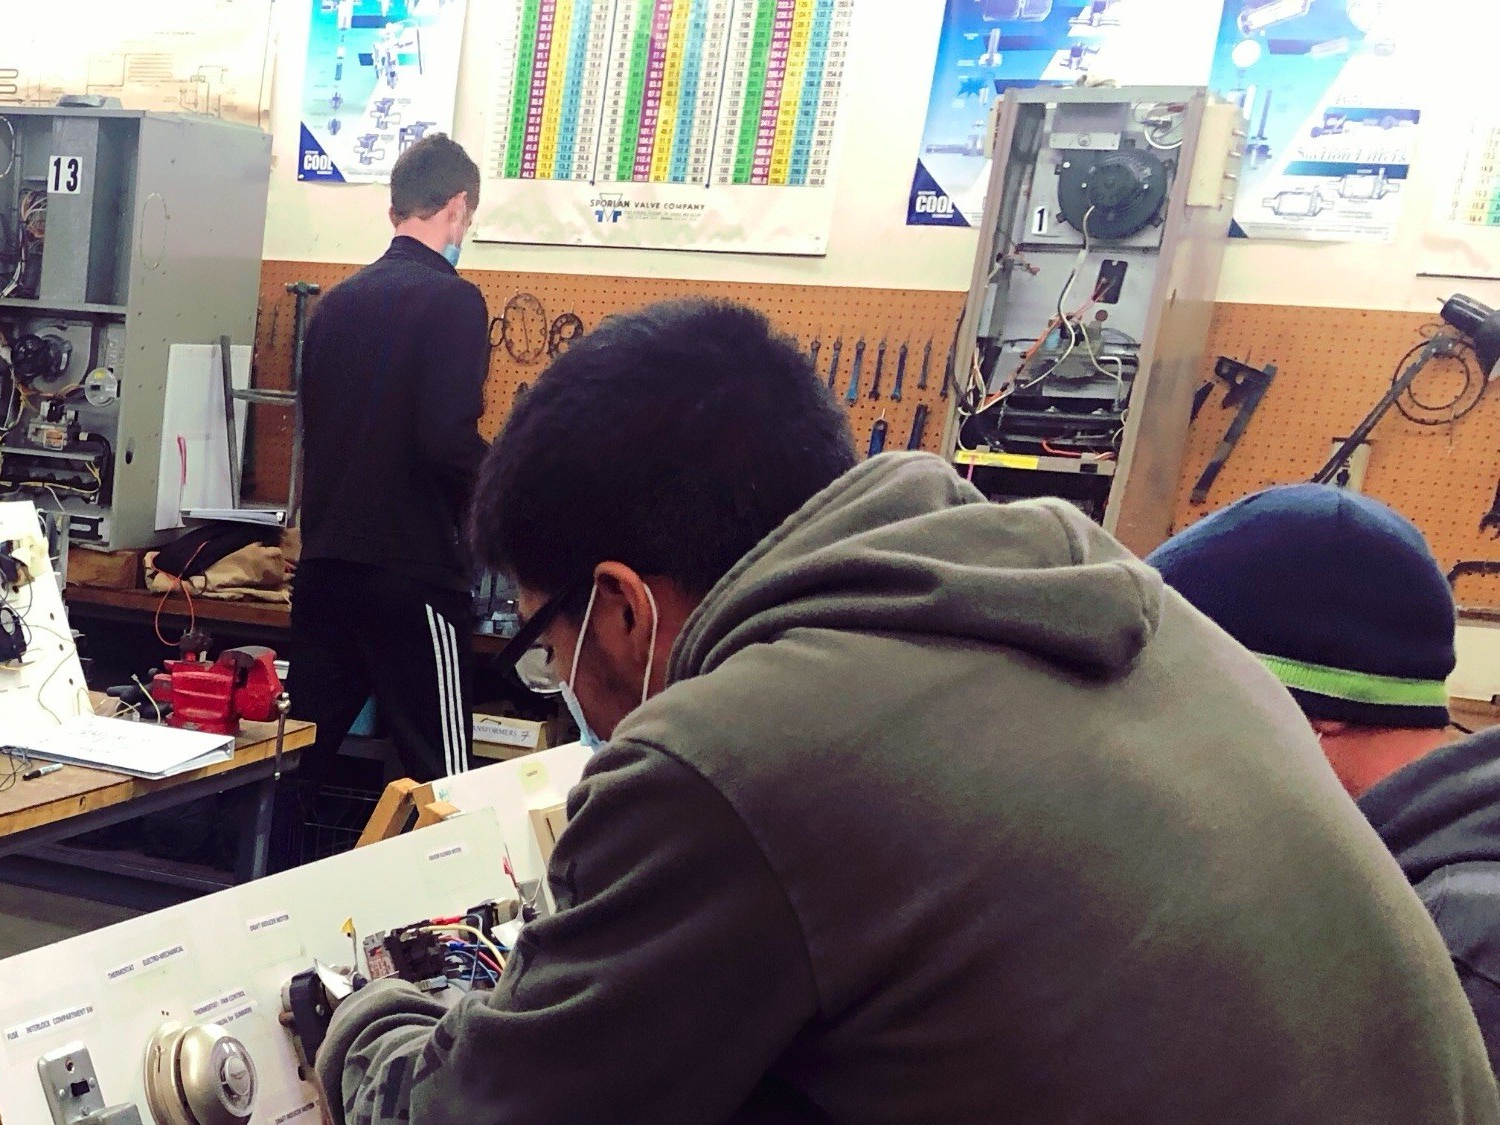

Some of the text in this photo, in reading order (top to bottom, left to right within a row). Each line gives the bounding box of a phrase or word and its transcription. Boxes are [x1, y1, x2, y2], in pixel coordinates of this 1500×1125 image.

[53, 157, 79, 192] 13
[590, 199, 630, 208] SPORLAN
[664, 203, 705, 211] COMPANY
[1037, 208, 1045, 232] 1
